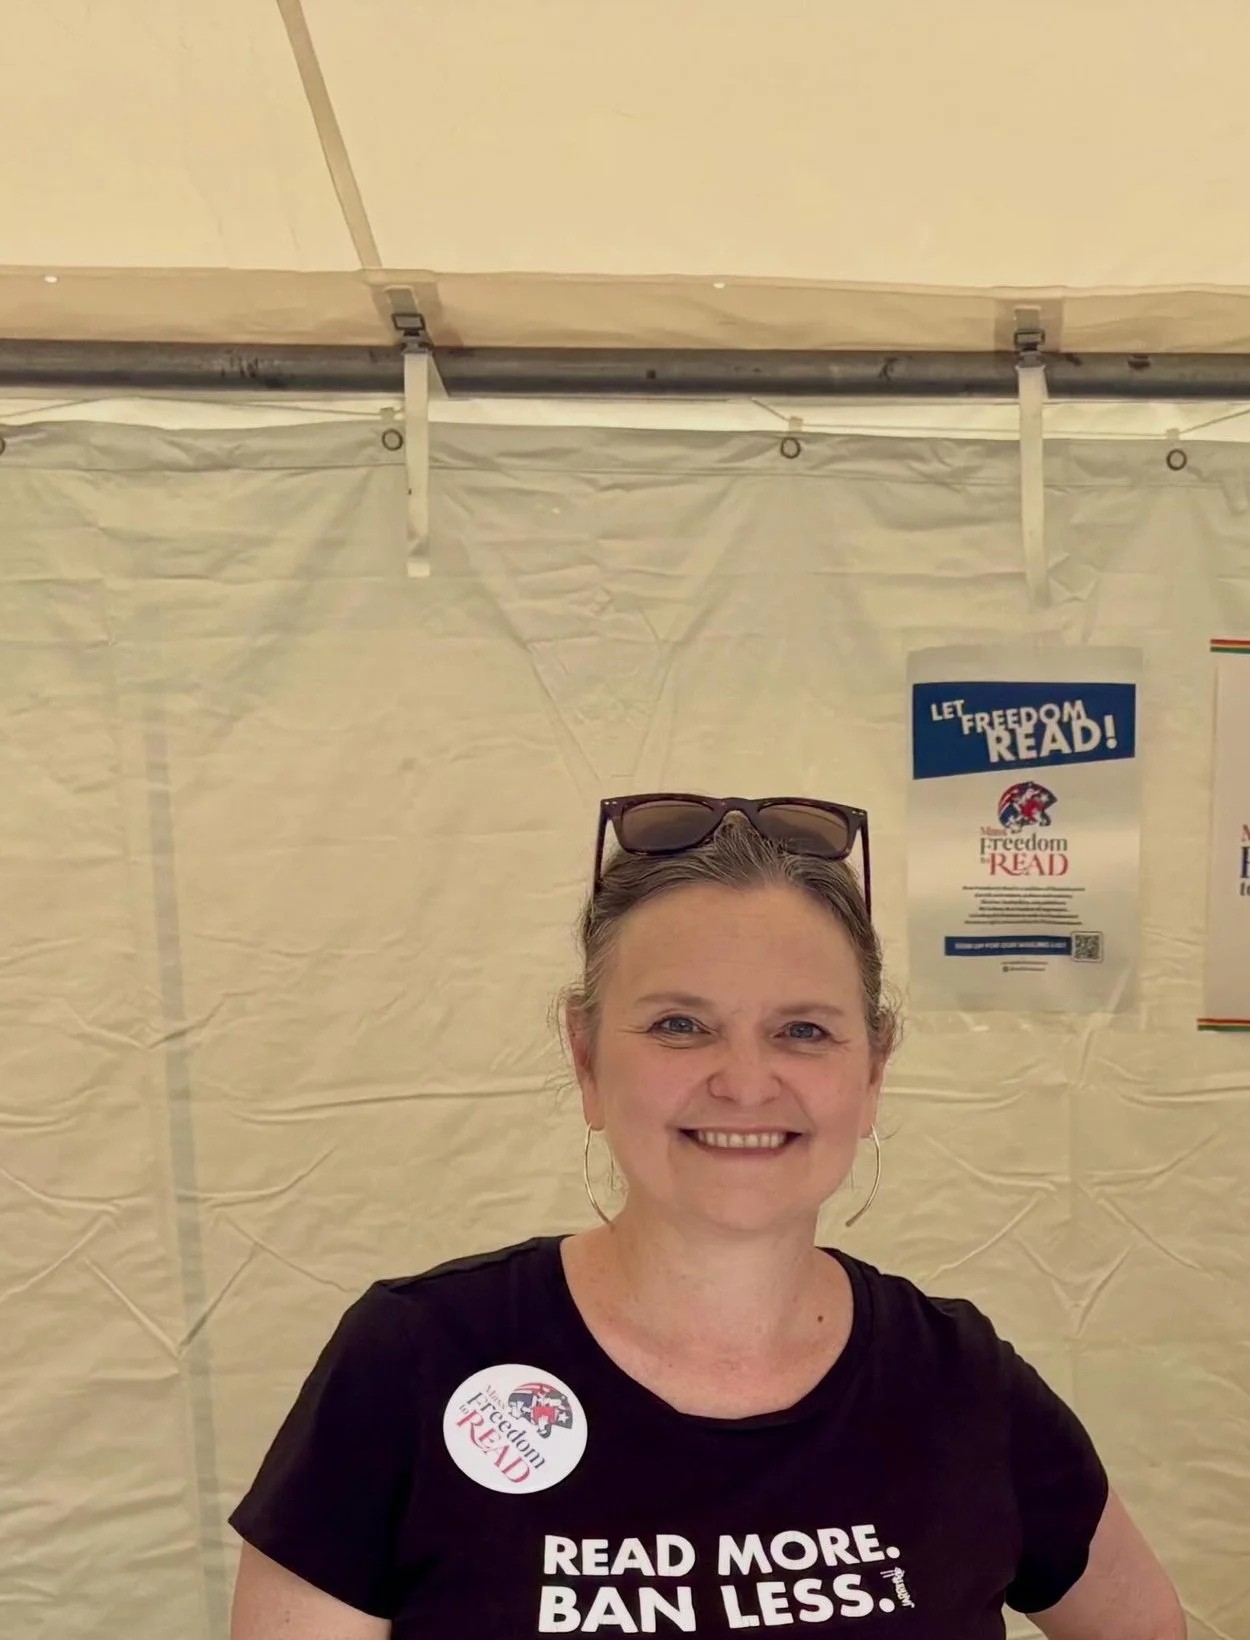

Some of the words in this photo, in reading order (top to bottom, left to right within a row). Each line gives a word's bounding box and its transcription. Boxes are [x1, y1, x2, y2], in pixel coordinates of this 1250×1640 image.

[931, 700, 965, 722] LET
[961, 700, 1087, 735] FREEDOM
[988, 715, 1118, 762] READ!
[981, 833, 1068, 855] Freedom
[989, 852, 1069, 876] READ
[456, 1408, 530, 1483] READ
[467, 1392, 546, 1469] Freedom
[544, 1534, 696, 1577] READ
[718, 1524, 901, 1576] MORE.
[538, 1586, 697, 1633] BAN
[720, 1574, 895, 1629] LESS.
